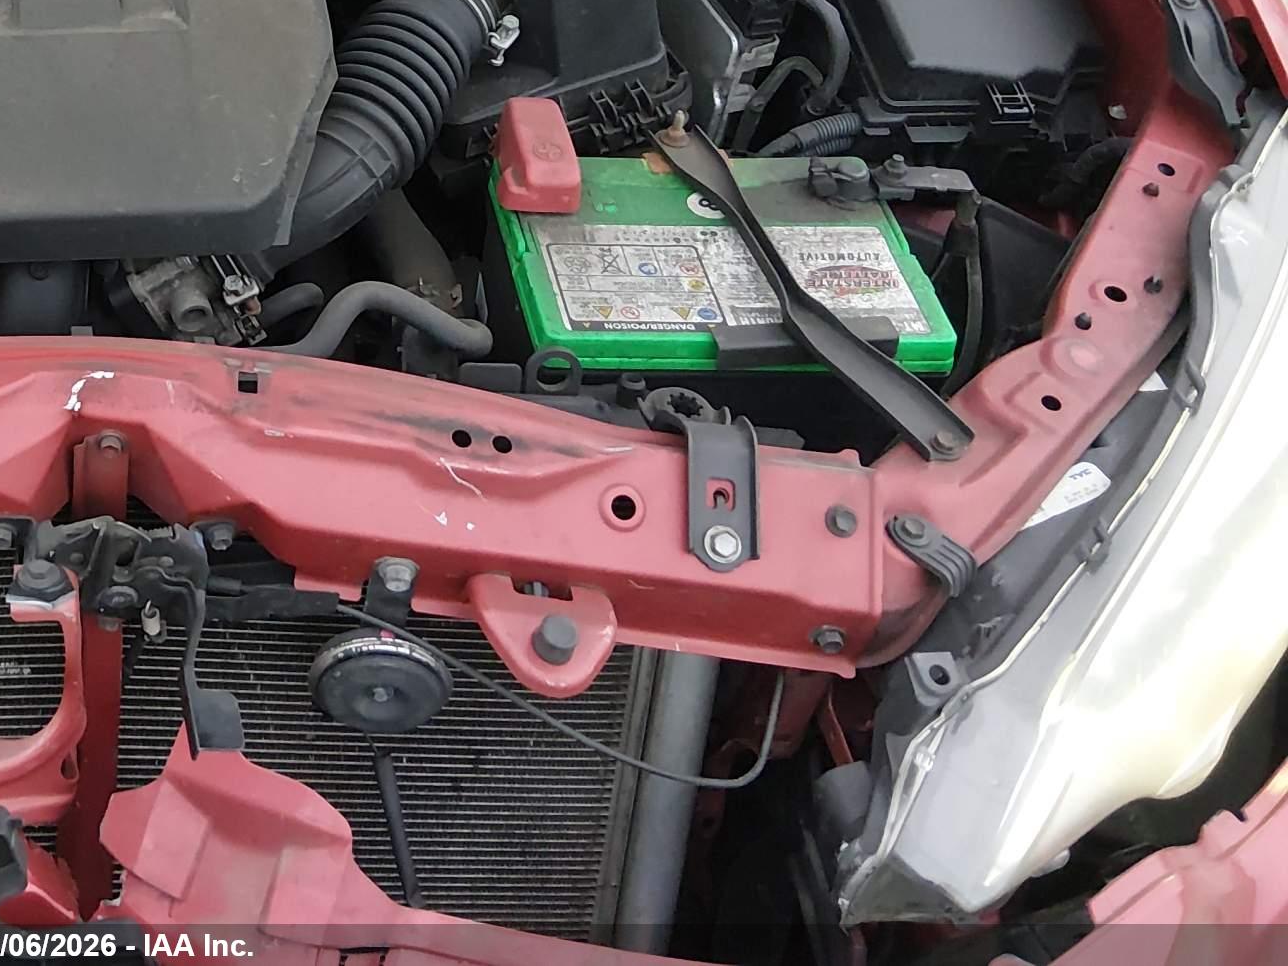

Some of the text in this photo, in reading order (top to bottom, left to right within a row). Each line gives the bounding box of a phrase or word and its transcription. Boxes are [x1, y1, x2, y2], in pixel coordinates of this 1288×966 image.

[798, 252, 880, 261] AUTOMOTIVE
[808, 270, 893, 279] BATTERIES
[805, 279, 899, 288] INTERSTATE
[604, 322, 696, 331] DANGER/POISON
